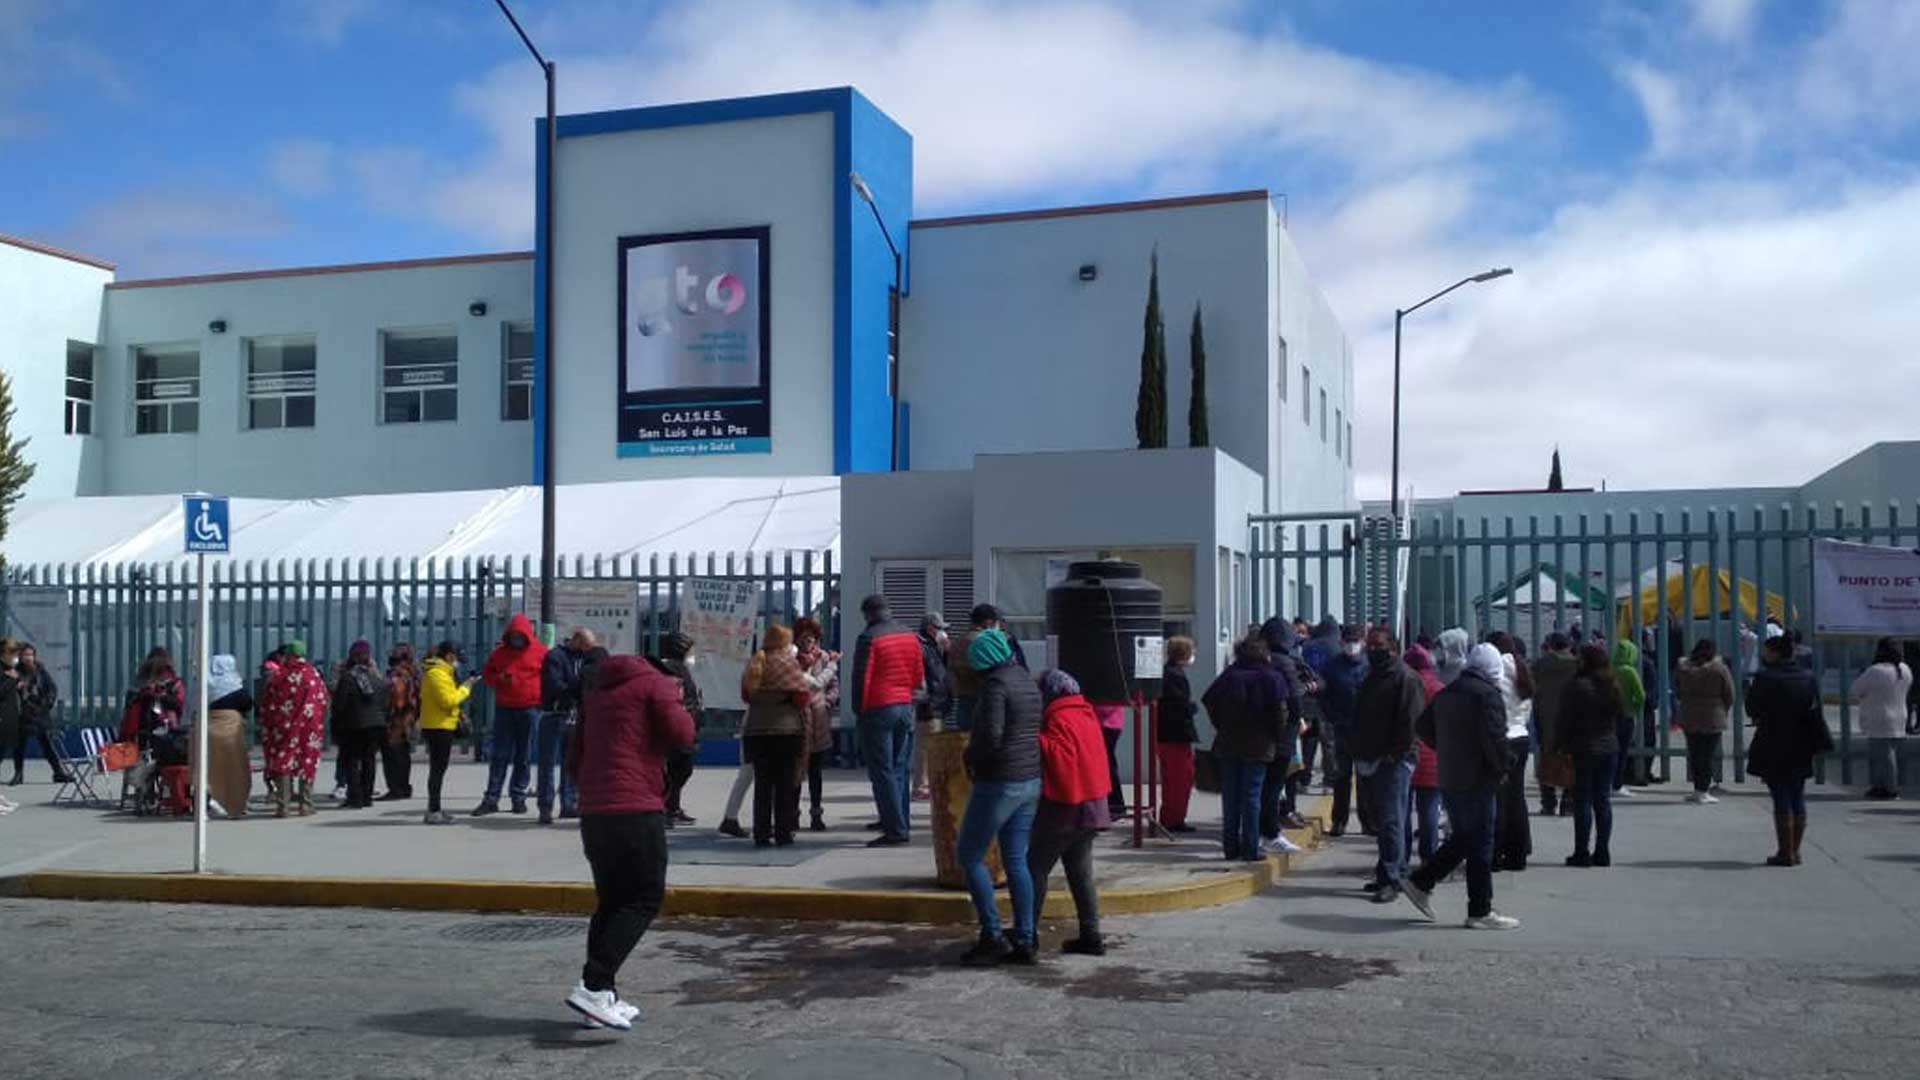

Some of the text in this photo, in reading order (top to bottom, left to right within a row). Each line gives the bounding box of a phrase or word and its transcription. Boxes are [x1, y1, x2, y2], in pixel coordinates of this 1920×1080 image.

[638, 424, 748, 439] San Luis de la Paz
[1838, 576, 1915, 587] PUNTO DE
